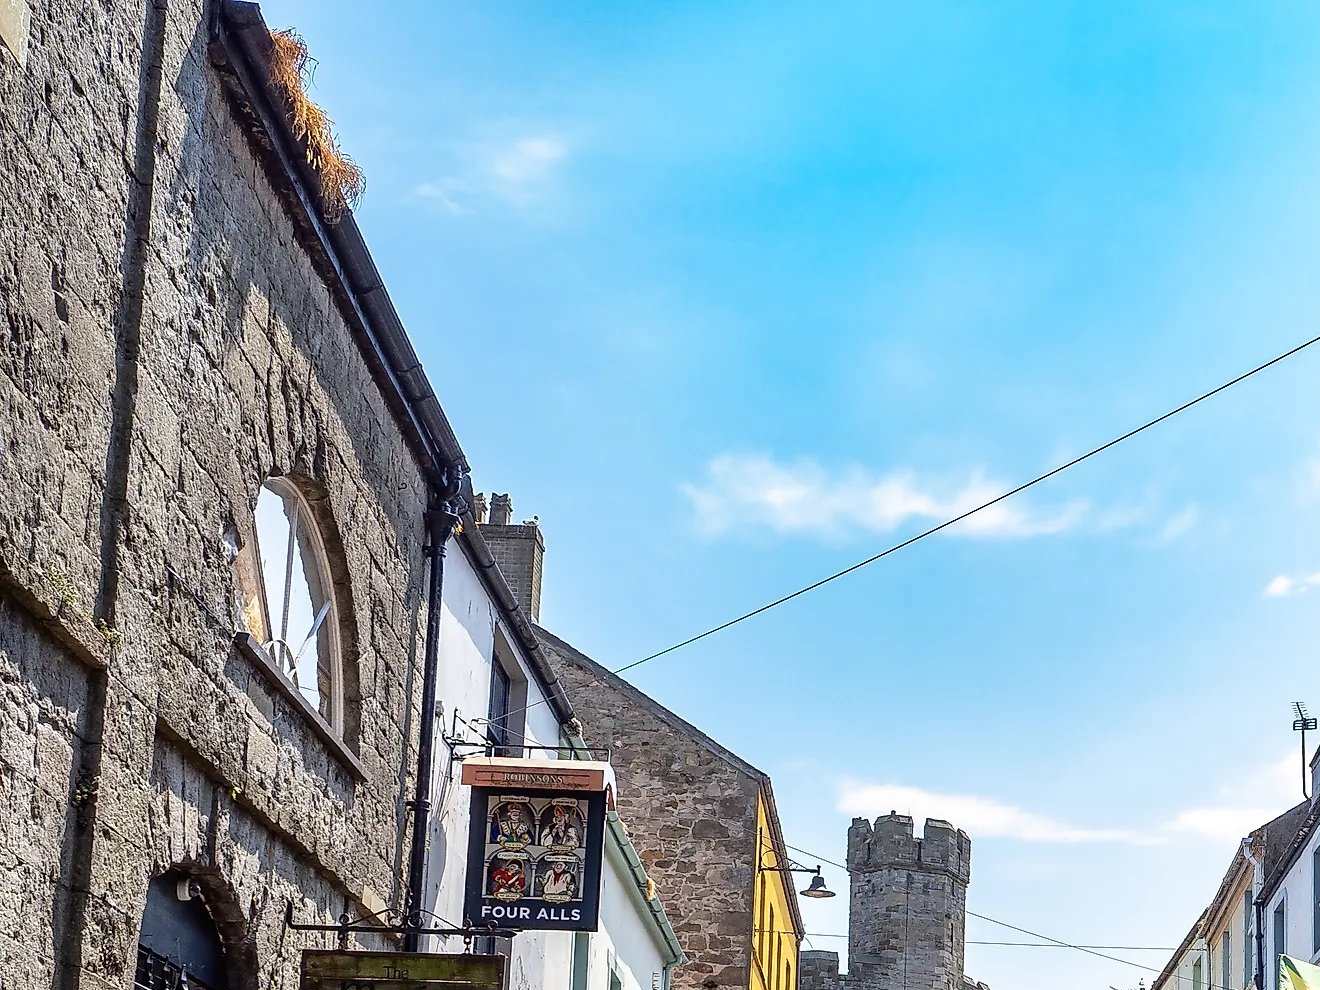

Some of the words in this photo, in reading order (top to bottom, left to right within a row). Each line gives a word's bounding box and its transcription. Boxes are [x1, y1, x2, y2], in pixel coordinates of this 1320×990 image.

[503, 772, 564, 785] ROBINSONS
[481, 905, 531, 919] FOUR
[536, 907, 581, 921] ALLS
[383, 965, 409, 979] The
